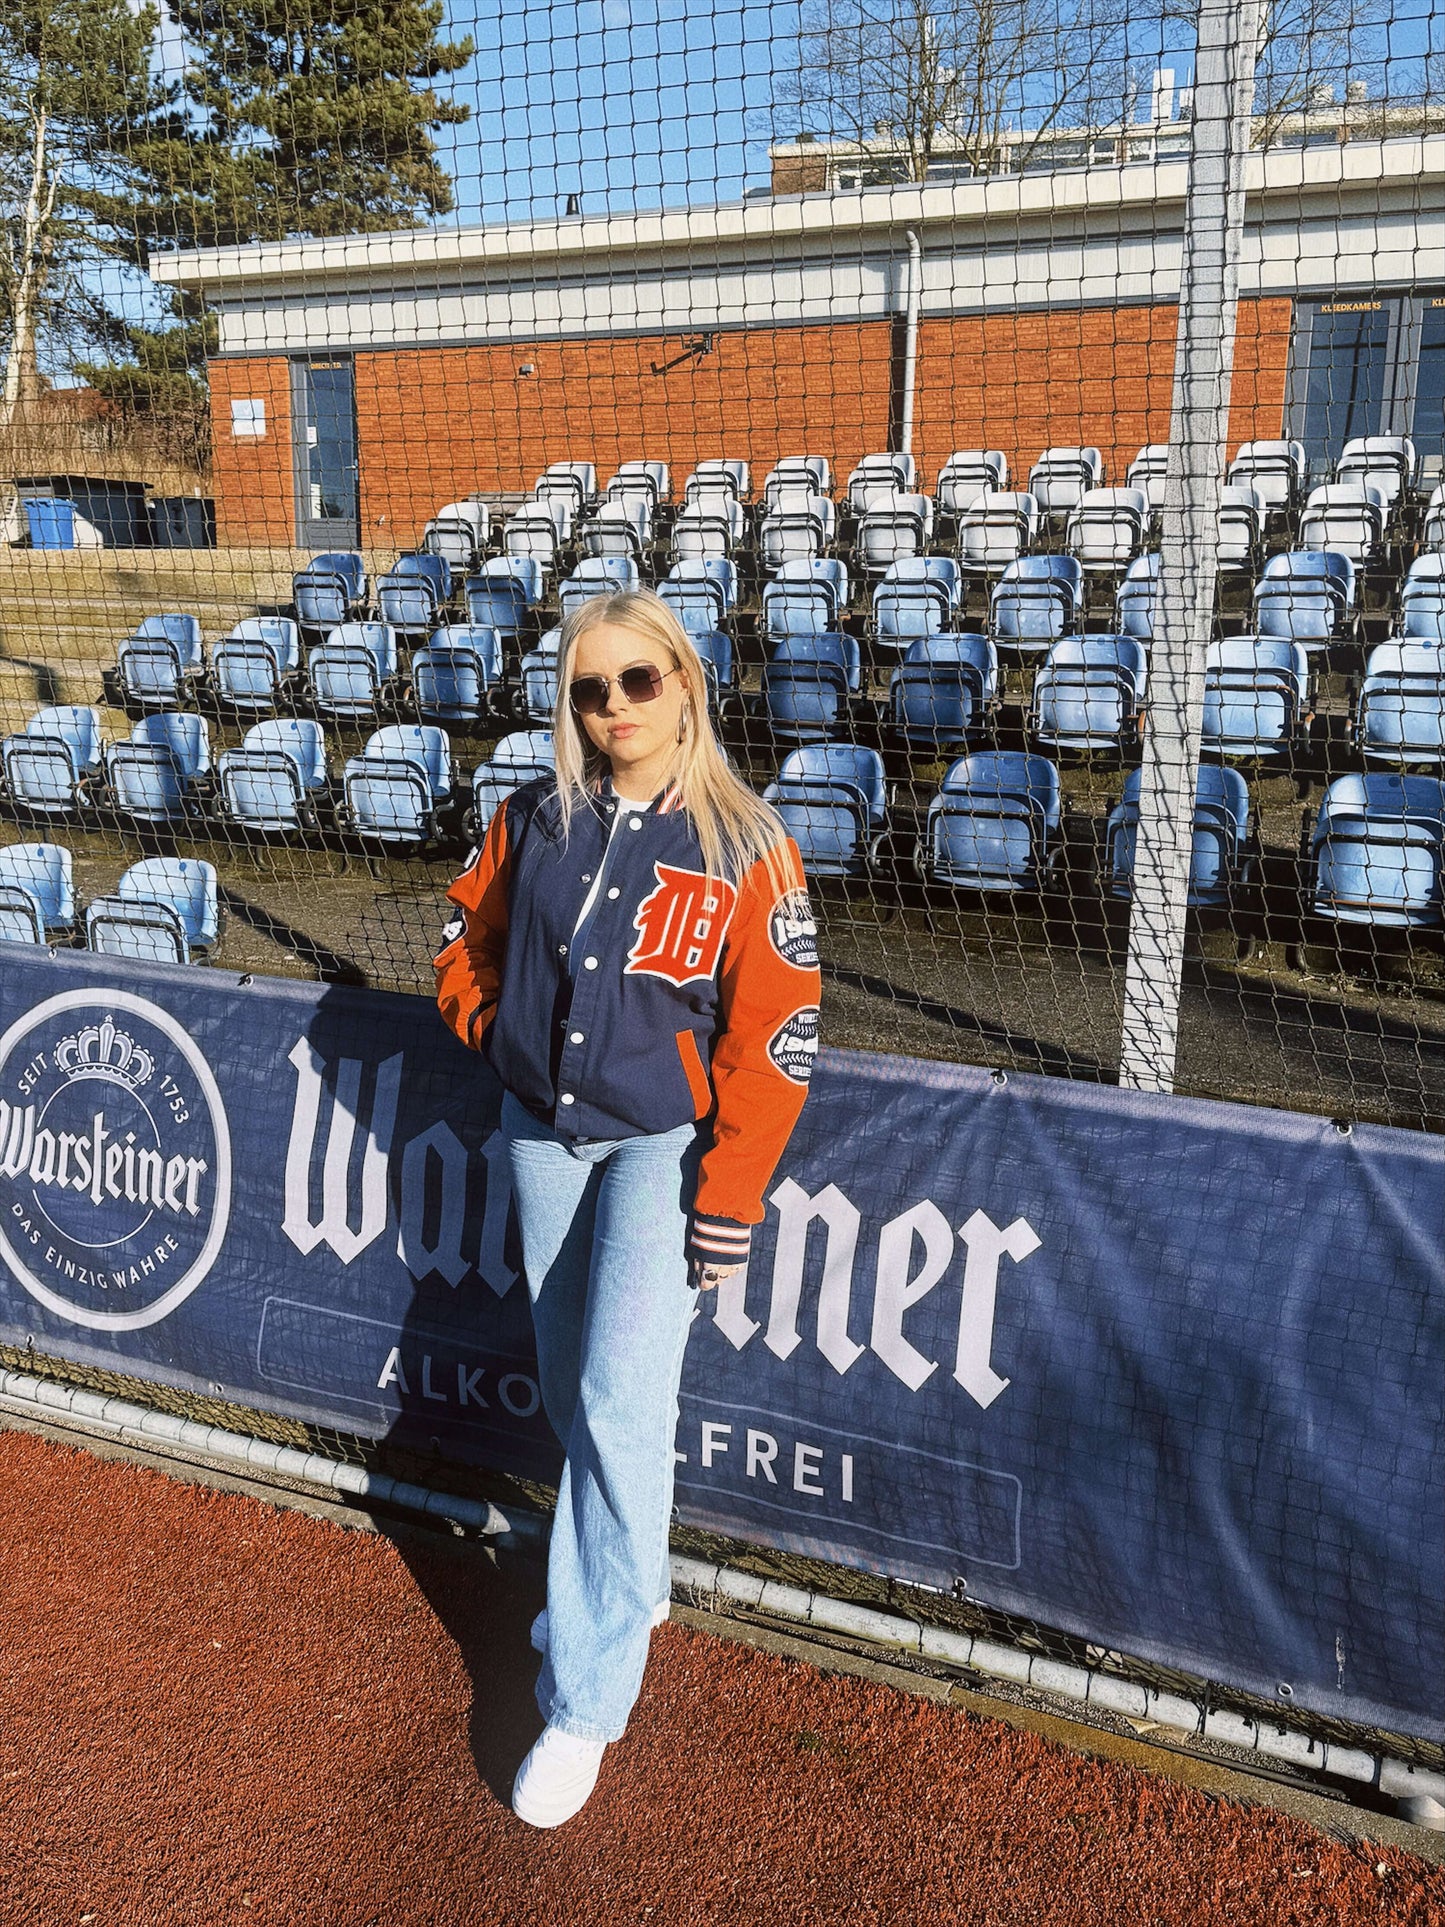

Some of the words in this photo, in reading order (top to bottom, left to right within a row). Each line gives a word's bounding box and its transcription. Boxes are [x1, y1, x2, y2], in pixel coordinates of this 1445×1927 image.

[1321, 301, 1382, 312] KLEEDKAMERS
[623, 860, 738, 988] D
[798, 1013, 819, 1024] WORL
[18, 1053, 47, 1095] SEIT
[160, 1074, 190, 1124] 1753
[0, 1098, 208, 1217] Warsteiner
[11, 1203, 40, 1245] DAS
[45, 1246, 108, 1290] EINZIG
[112, 1233, 180, 1289] WAHRE
[377, 1346, 854, 1502] ALKOFREI
